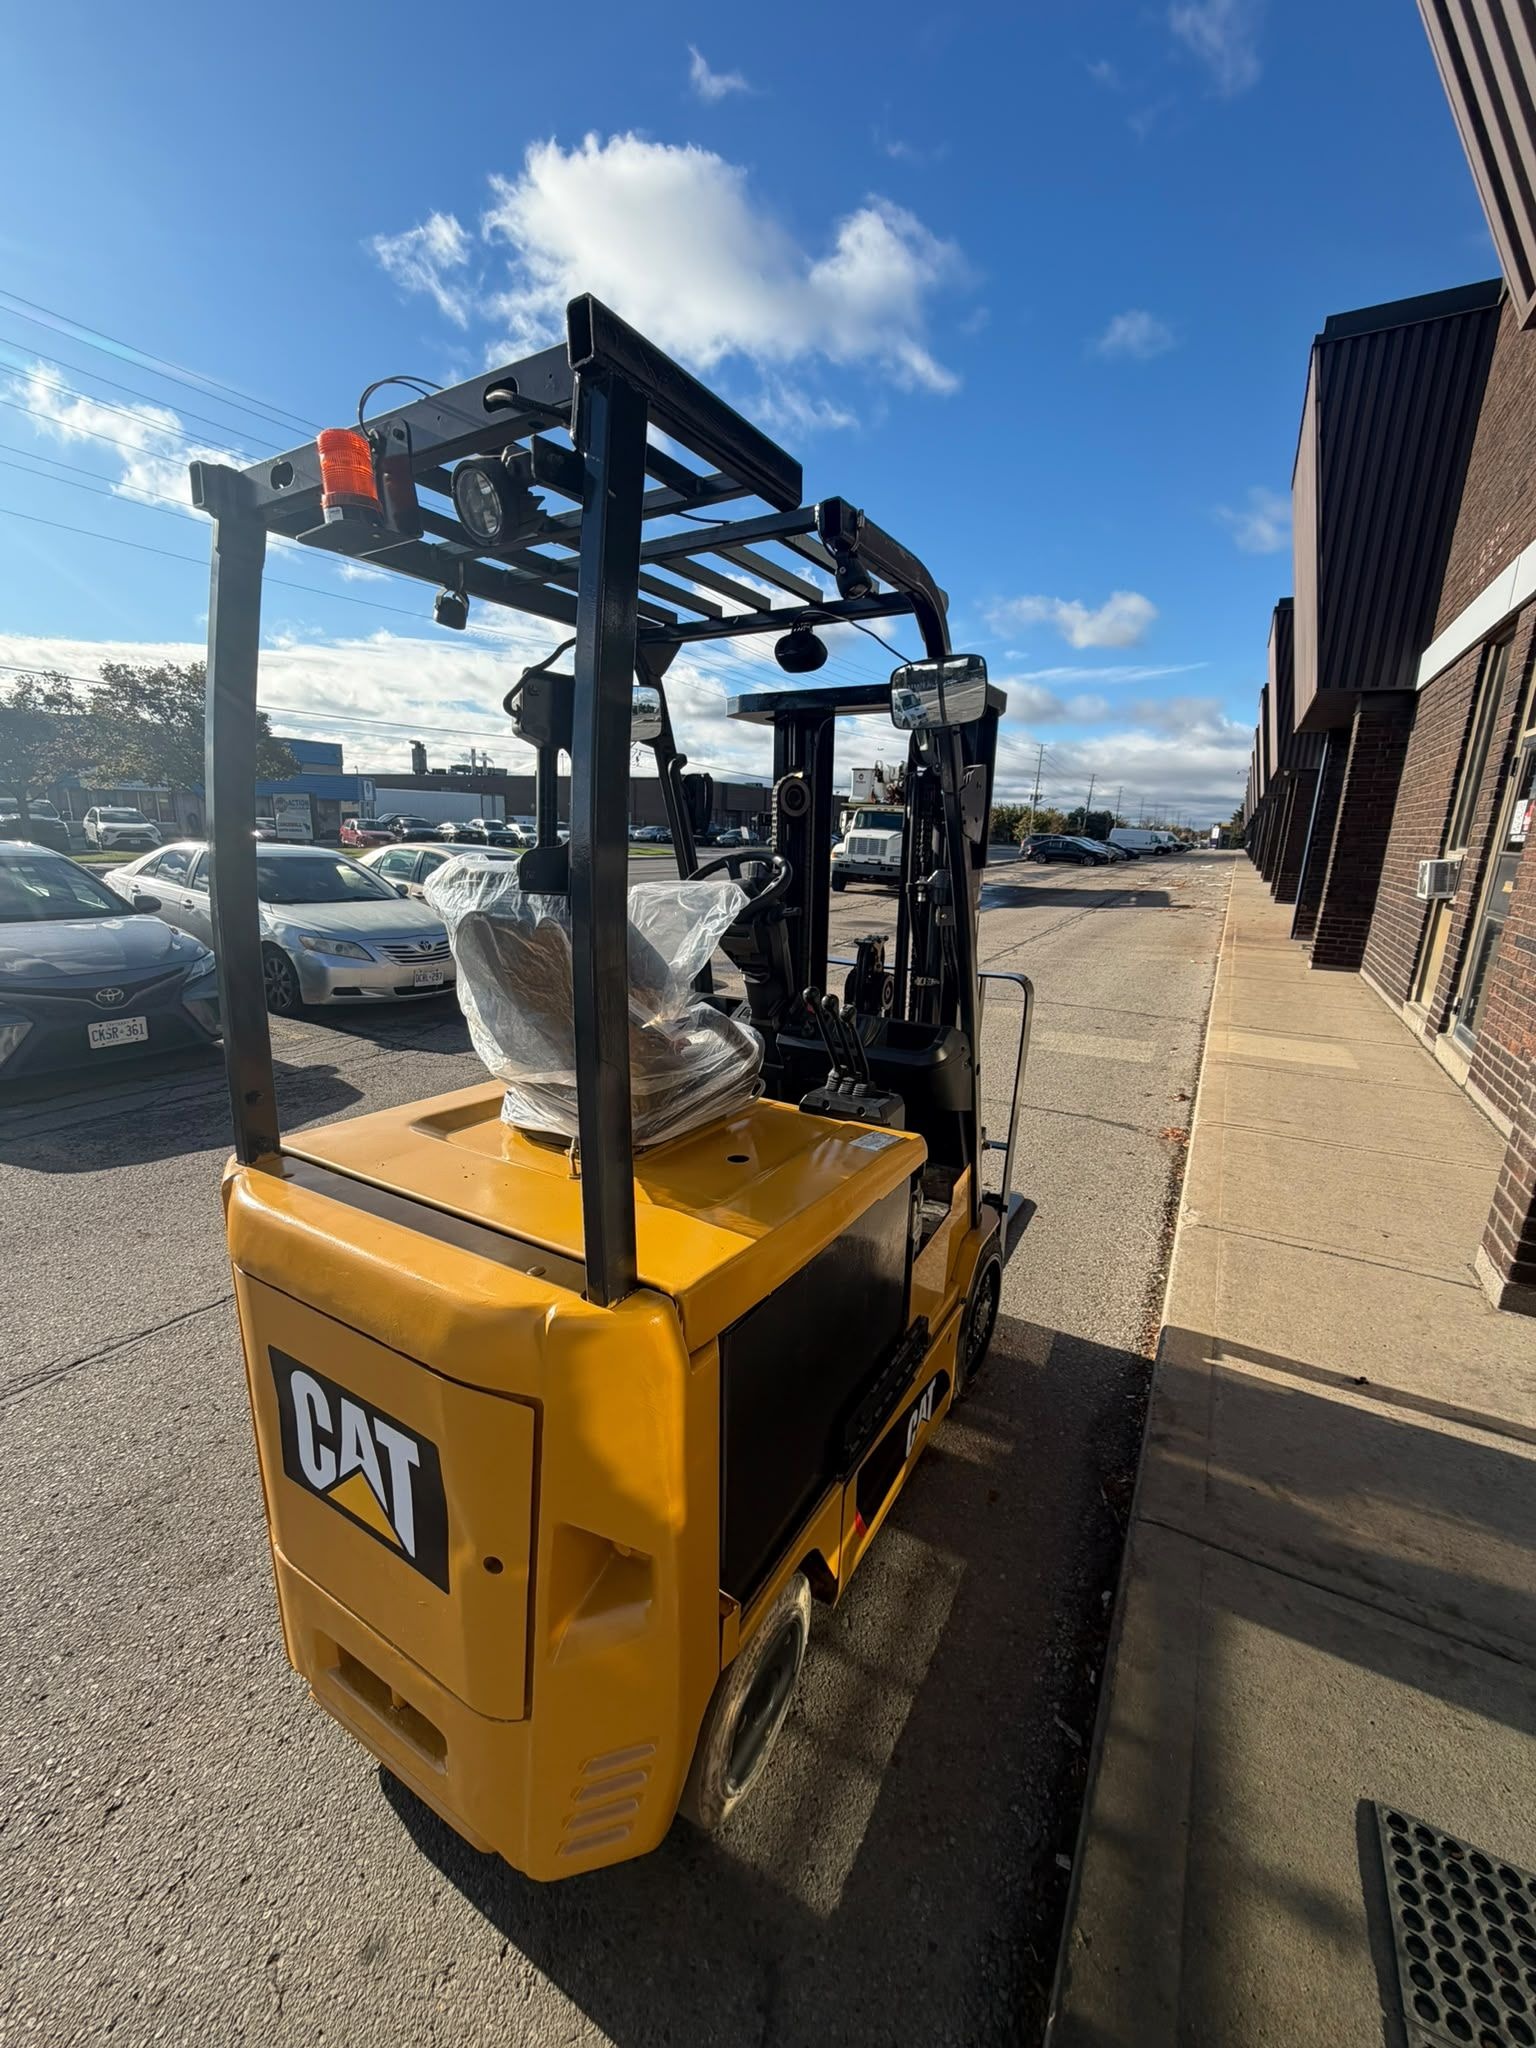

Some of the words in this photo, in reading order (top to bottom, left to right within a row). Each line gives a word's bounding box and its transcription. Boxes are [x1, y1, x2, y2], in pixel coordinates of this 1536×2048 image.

[288, 799, 309, 807] ACTION
[126, 1023, 145, 1037] 361
[906, 1377, 937, 1458] CAT
[290, 1369, 421, 1559] CAT
